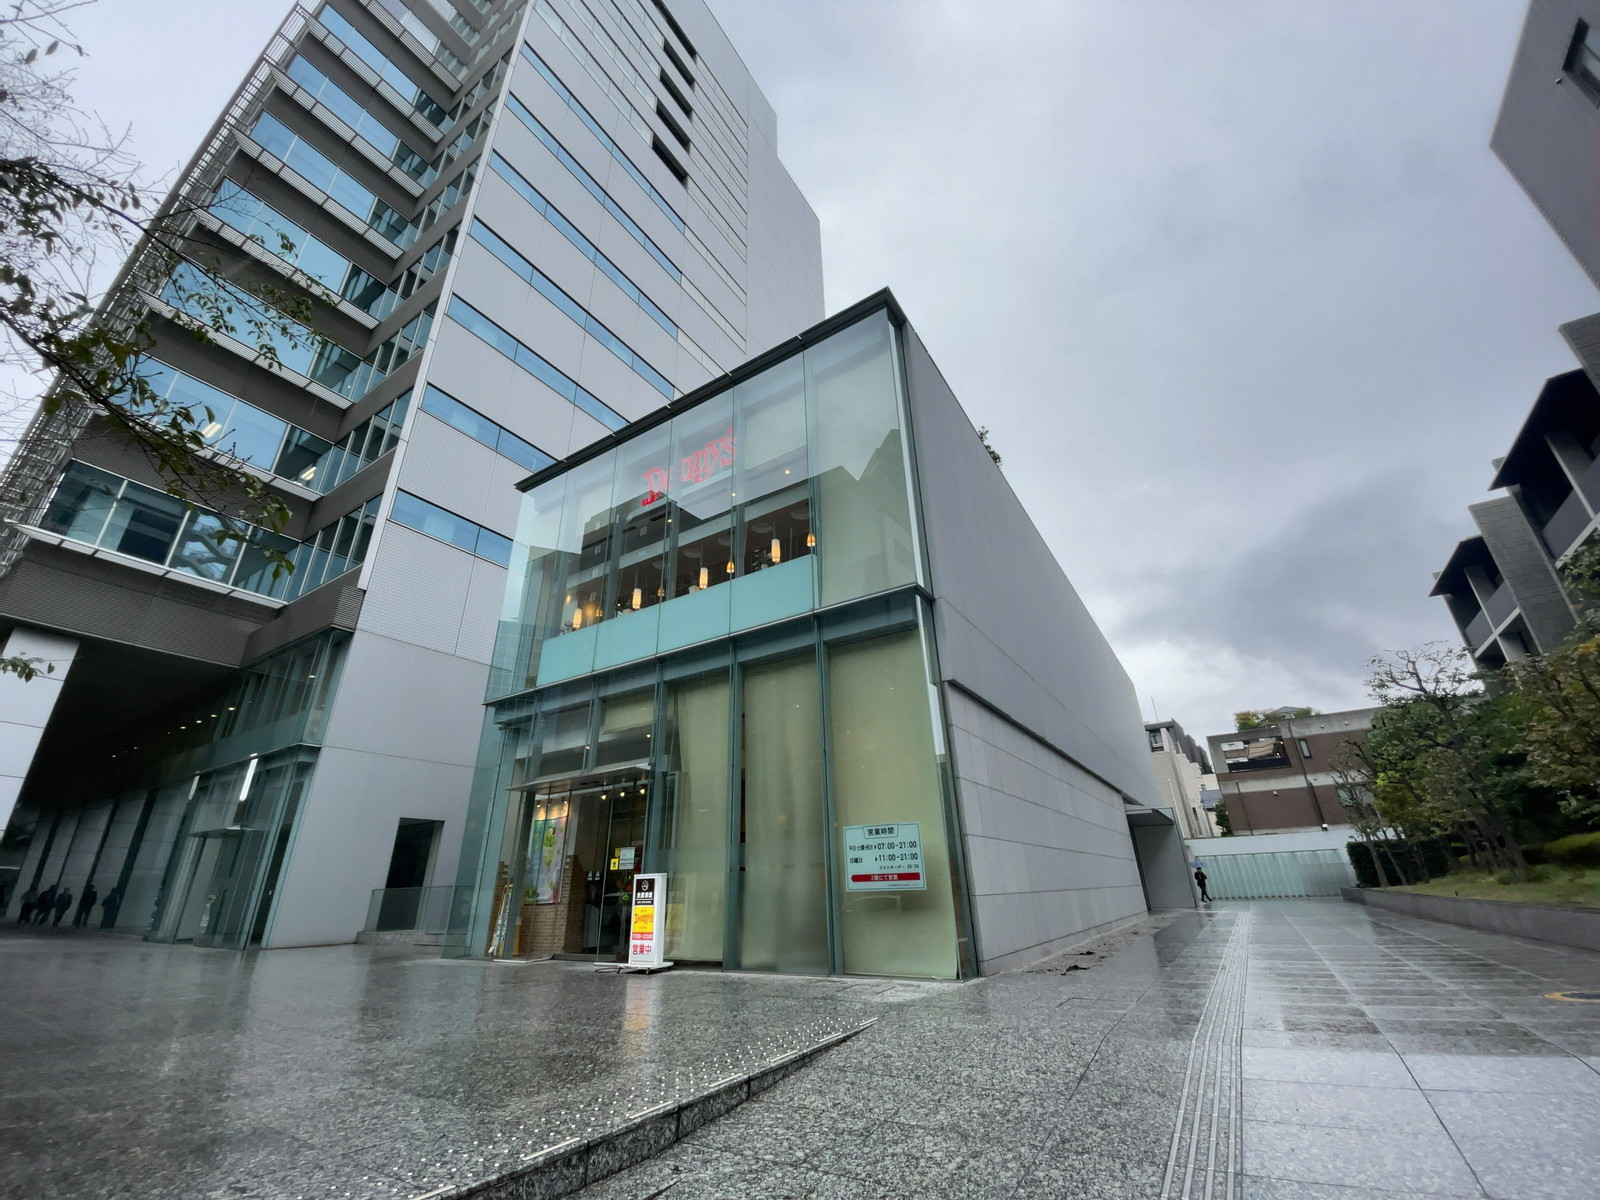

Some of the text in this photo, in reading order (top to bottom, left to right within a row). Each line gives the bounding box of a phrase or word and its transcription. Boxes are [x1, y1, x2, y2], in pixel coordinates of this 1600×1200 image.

[867, 827, 895, 836] 営業時間
[632, 944, 652, 956] 営業中
